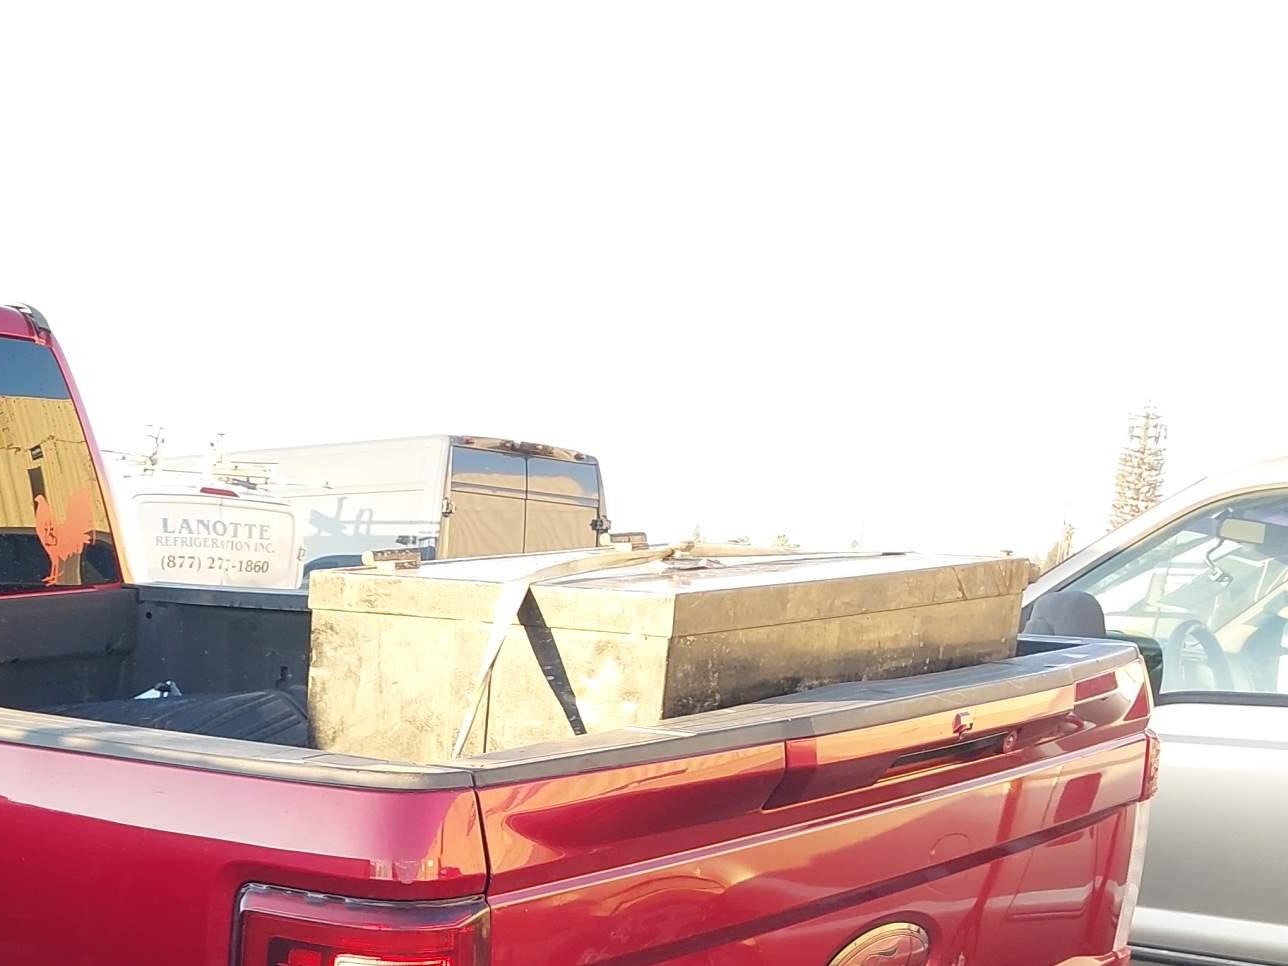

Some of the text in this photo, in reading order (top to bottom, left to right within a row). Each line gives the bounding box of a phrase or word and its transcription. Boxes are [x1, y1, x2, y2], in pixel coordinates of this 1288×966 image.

[160, 517, 272, 541] LANOTTE
[254, 542, 276, 554] INC.
[160, 555, 202, 572] (877)
